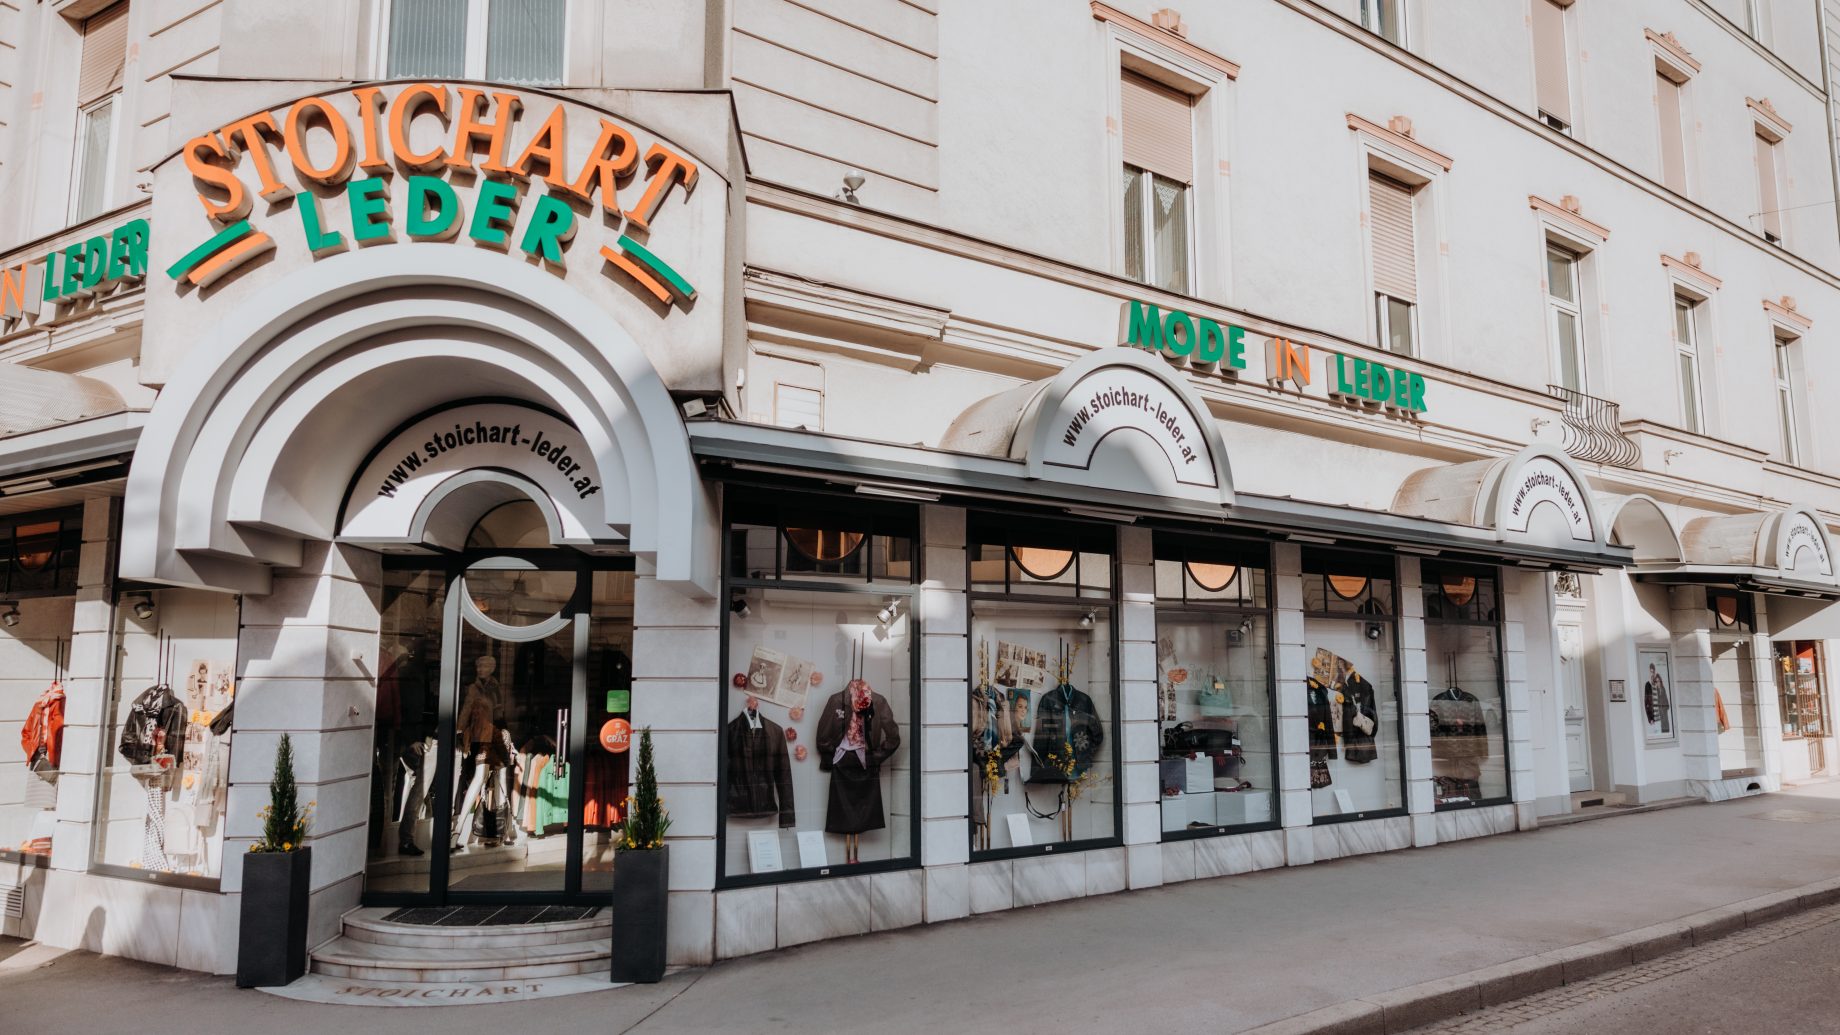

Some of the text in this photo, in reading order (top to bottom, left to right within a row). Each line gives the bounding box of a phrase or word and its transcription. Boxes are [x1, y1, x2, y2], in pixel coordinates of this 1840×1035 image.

[181, 83, 699, 229] STOICHART
[43, 218, 151, 302] LEDER
[296, 176, 579, 264] LEDER
[1127, 300, 1428, 413] MODE IN LEDER
[377, 421, 601, 500] www.stoichart-leder.at
[1063, 385, 1198, 465] www.stoichart-leder.at
[1512, 470, 1582, 525] www.stoichart-leder.at
[606, 734, 629, 744] GRAZ
[335, 983, 543, 998] STOICHART
